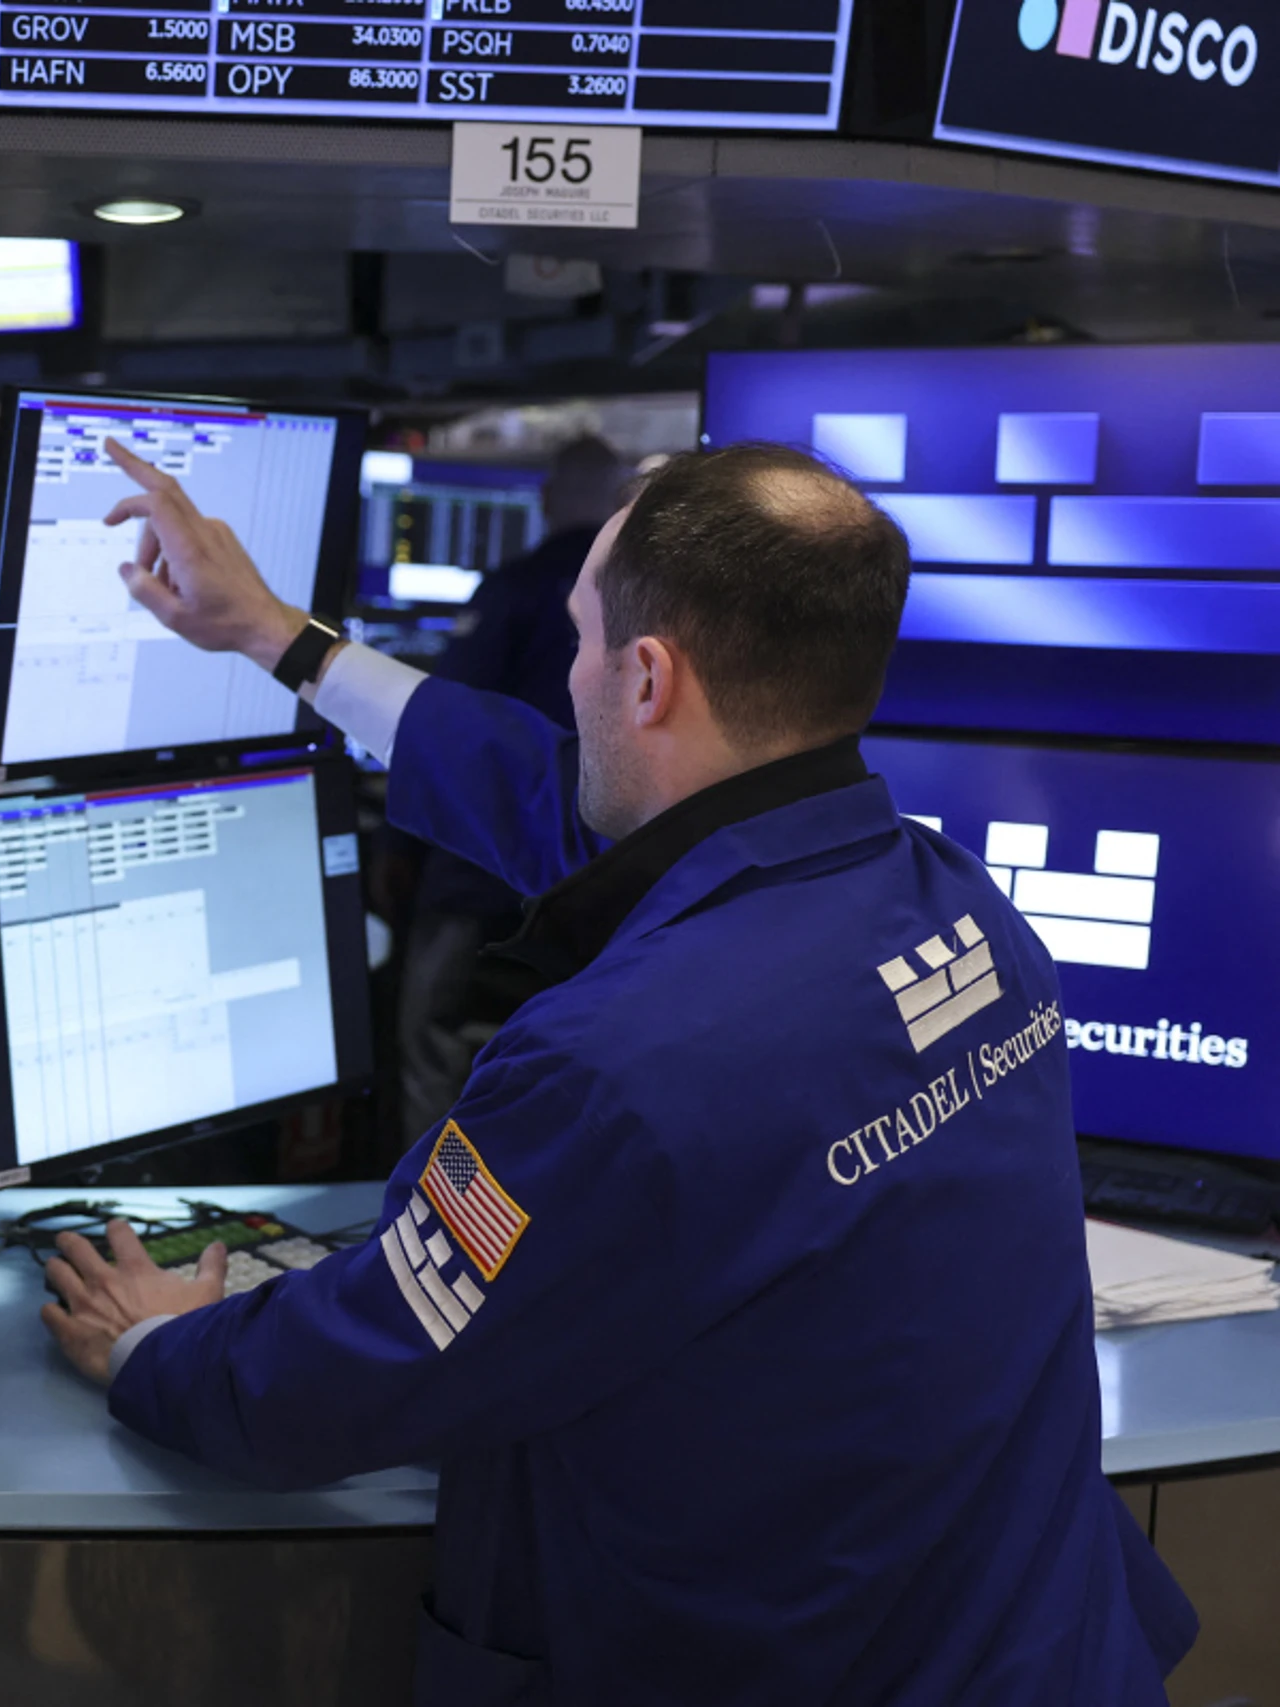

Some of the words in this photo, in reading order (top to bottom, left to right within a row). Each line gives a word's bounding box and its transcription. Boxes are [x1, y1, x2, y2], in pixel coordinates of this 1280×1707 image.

[12, 15, 89, 42] GROV
[147, 19, 208, 39] 1.5000
[230, 21, 295, 52] MSB
[352, 26, 421, 46] 34.0300
[442, 30, 513, 56] PSQH
[571, 34, 630, 53] 0.7040
[1098, 1, 1258, 87] DISCO
[10, 58, 85, 85] HAFN
[145, 62, 206, 82] 6.5600
[228, 64, 293, 95] OPY
[348, 68, 418, 88] 86.3000
[439, 71, 494, 101] SST
[567, 75, 626, 95] 3.2600
[501, 136, 592, 184] 155
[479, 207, 520, 220] CITADEL
[527, 208, 585, 221] SECURITIES
[590, 210, 609, 222] LLC
[1064, 1017, 1249, 1068] ecurities
[827, 1068, 971, 1186] CITADEL
[979, 1000, 1061, 1087] Securities
